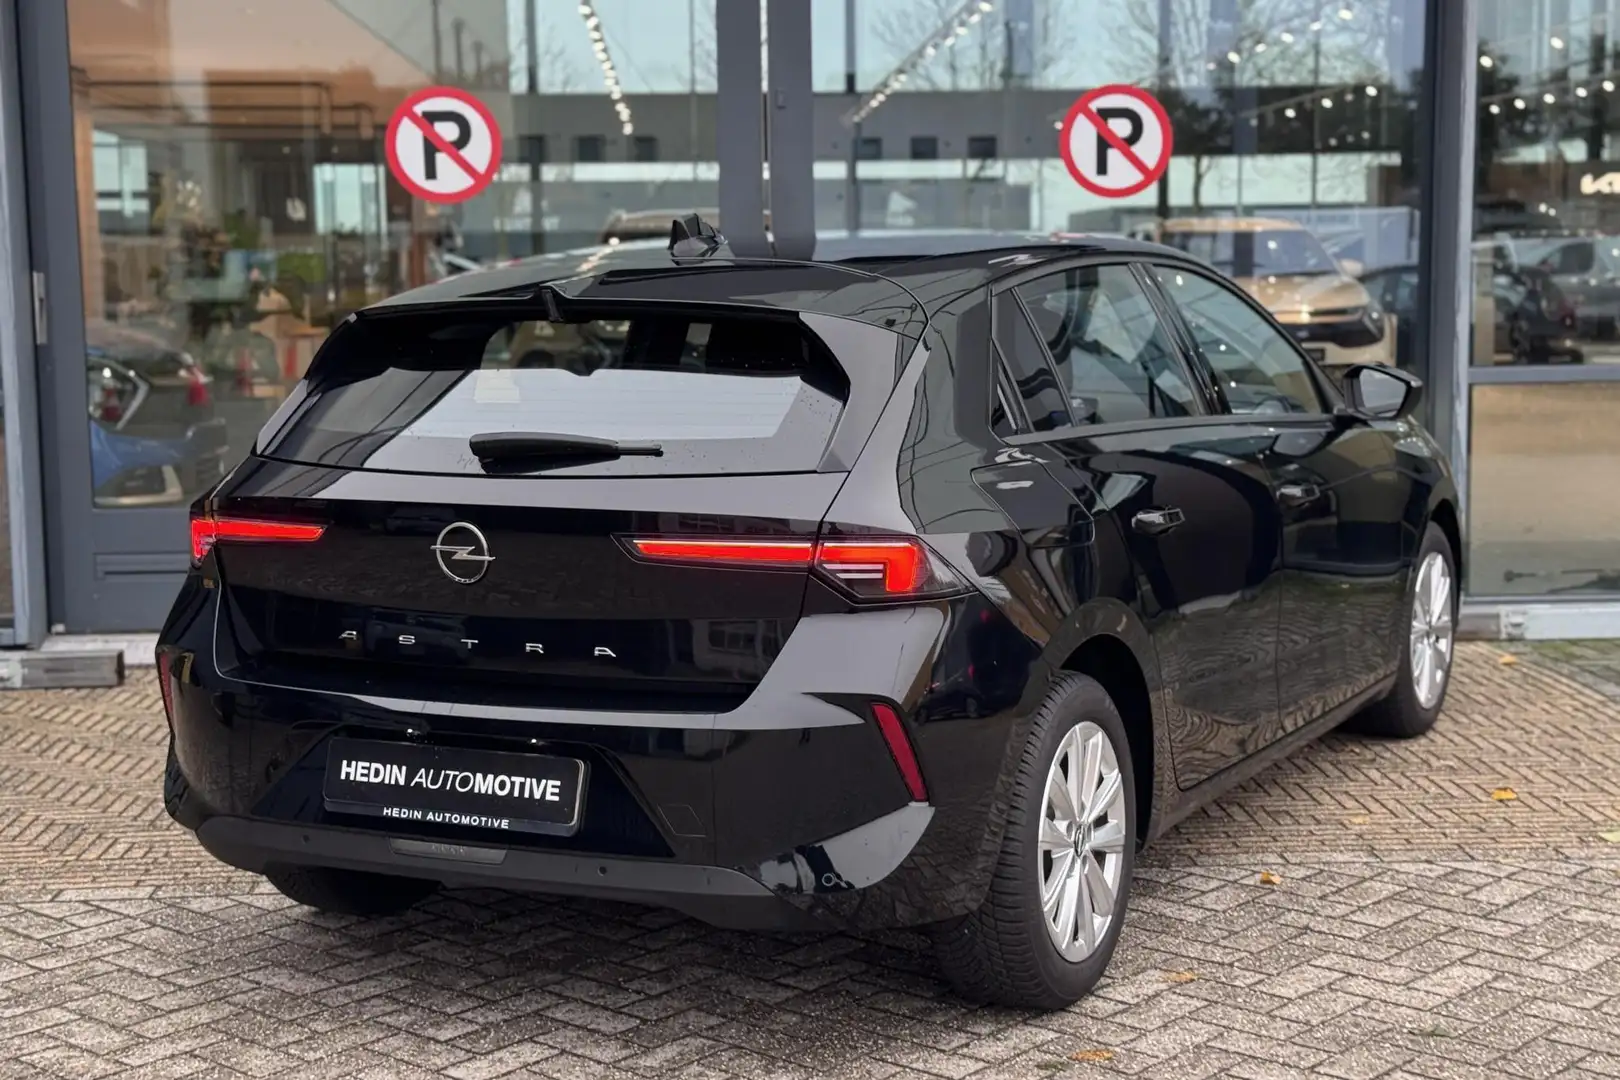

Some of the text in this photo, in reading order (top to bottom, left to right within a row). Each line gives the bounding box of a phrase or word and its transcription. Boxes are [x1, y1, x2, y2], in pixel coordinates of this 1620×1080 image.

[421, 110, 471, 180] P
[1096, 108, 1143, 176] P
[339, 630, 617, 658] ASTRA
[340, 759, 562, 801] HEDIN AUTOMOTIVE
[383, 806, 510, 829] HEDIN AUTOMOTIVE
